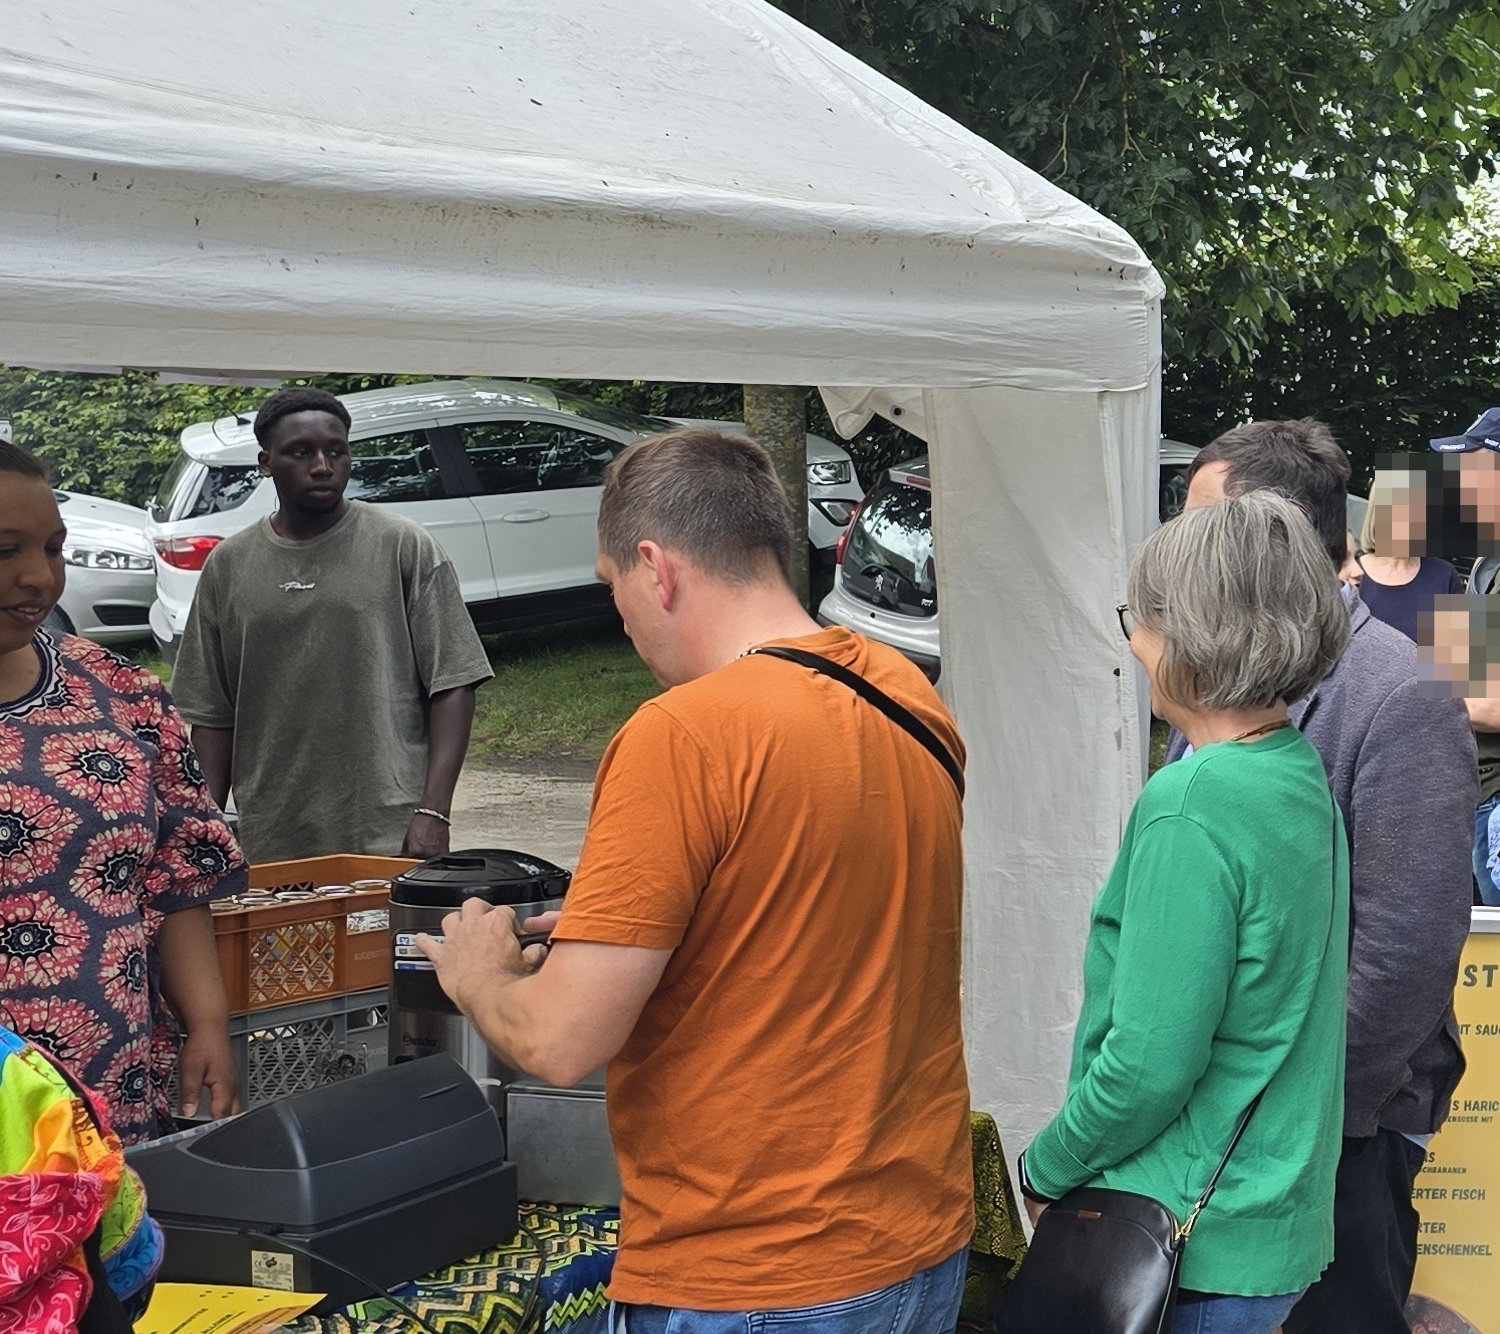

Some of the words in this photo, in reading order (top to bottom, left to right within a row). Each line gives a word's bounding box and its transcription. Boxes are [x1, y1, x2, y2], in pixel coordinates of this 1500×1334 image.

[1458, 1023, 1471, 1035] IT
[1452, 1189, 1485, 1200] FISCH
[1417, 1244, 1492, 1256] ENSCHENKEL
